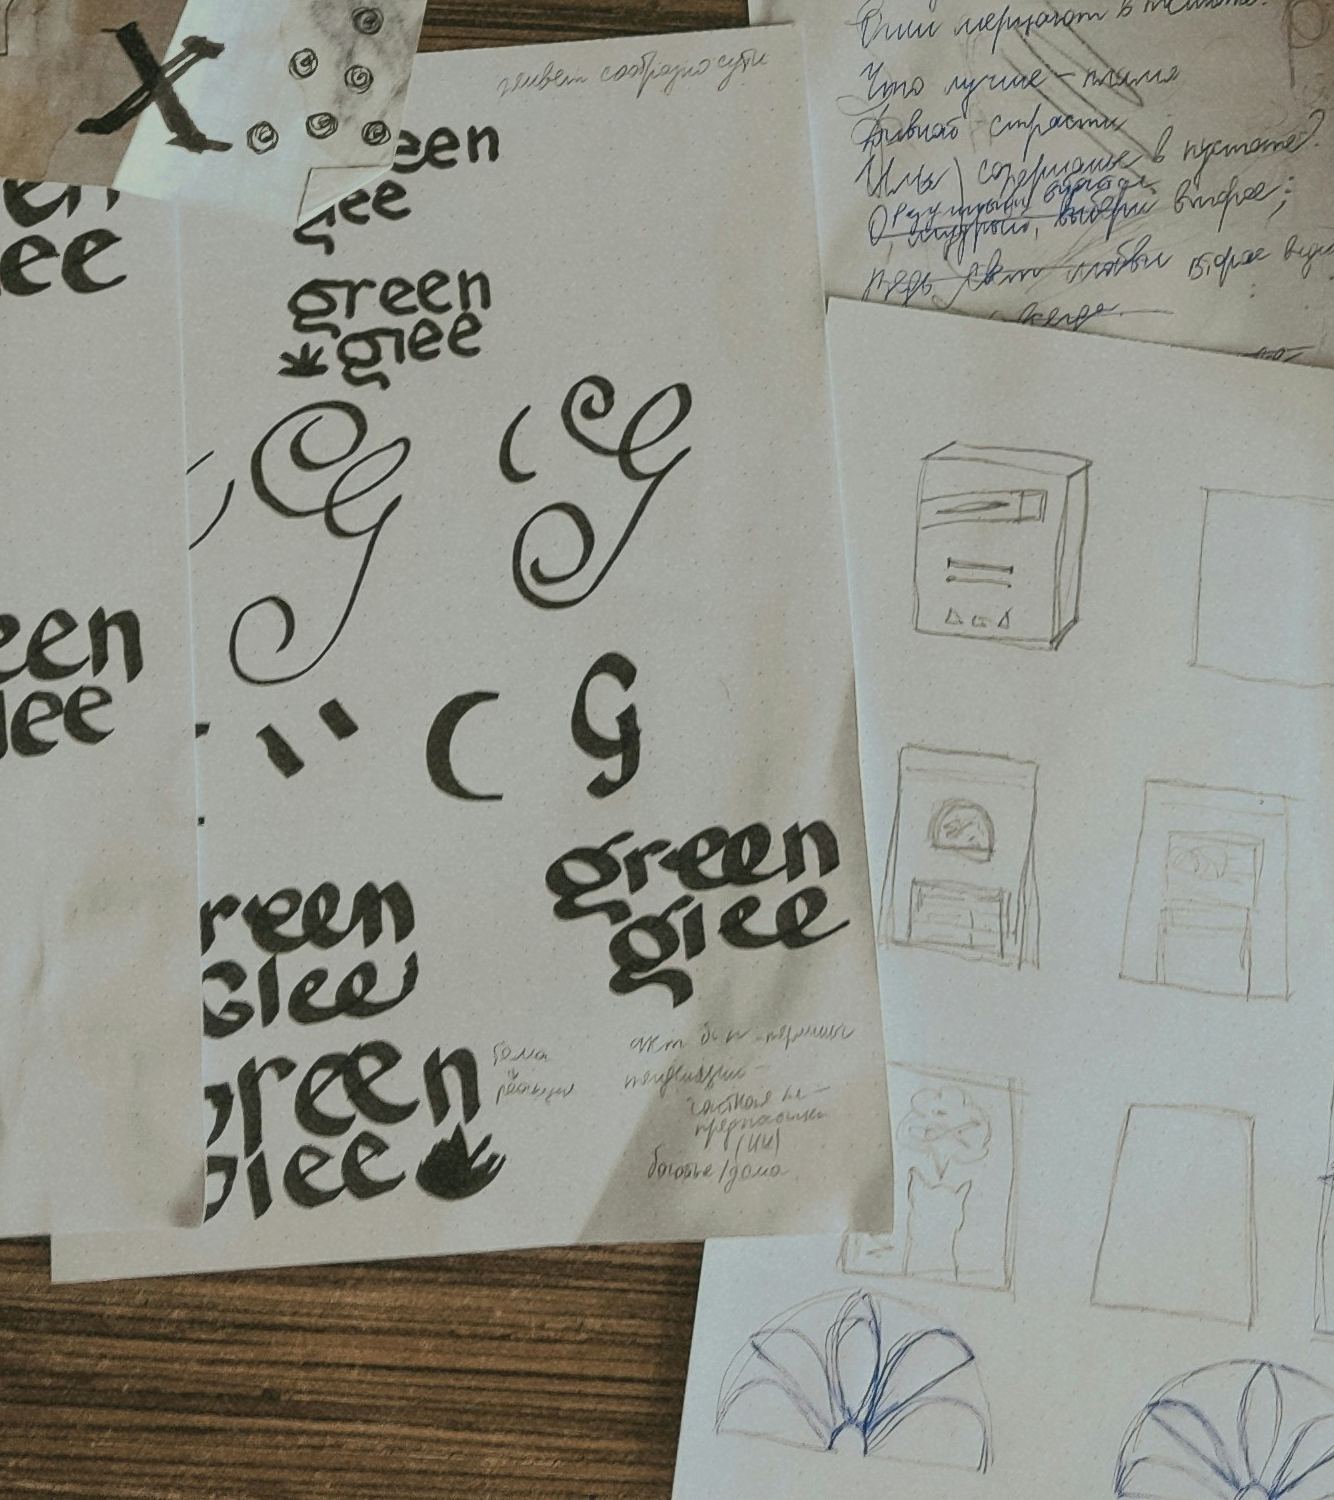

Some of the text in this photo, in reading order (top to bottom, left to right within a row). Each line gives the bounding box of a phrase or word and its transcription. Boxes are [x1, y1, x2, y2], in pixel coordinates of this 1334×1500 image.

[287, 268, 493, 340] green
[200, 880, 417, 956] reen
[544, 820, 841, 926] green
[607, 885, 851, 1009] glee
